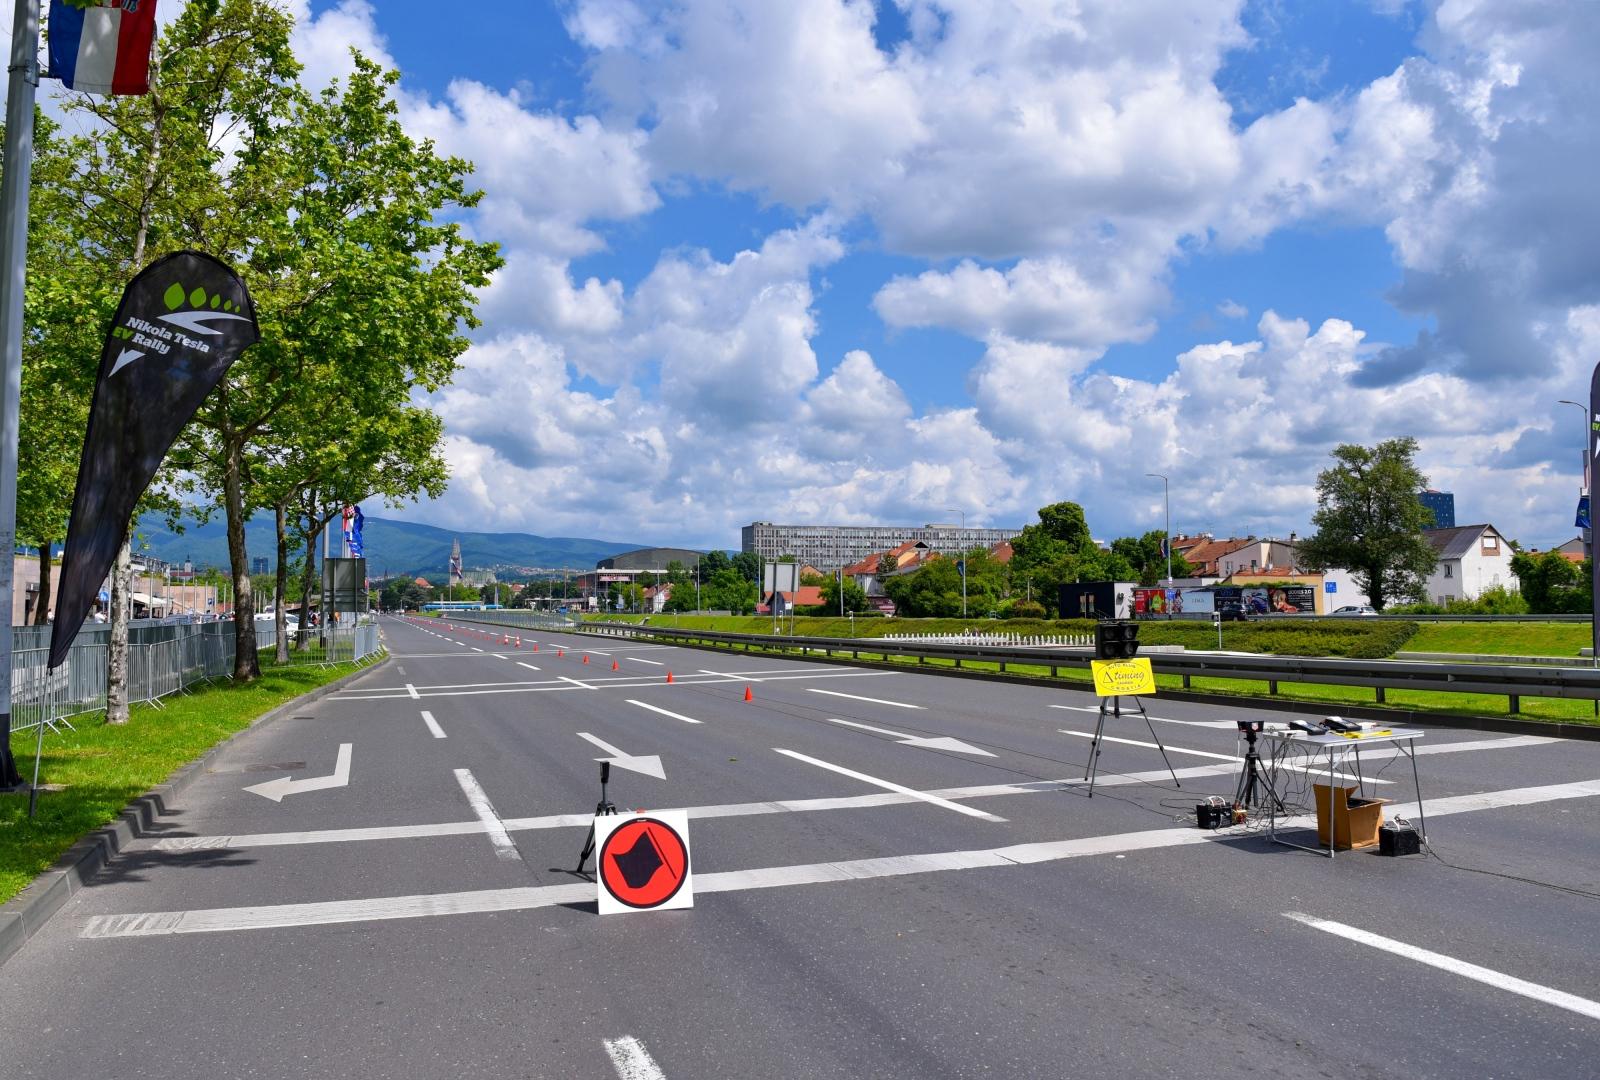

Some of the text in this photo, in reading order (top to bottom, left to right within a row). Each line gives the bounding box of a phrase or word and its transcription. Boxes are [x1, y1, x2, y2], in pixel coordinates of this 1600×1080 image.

[112, 326, 170, 354] EV Rally
[126, 317, 209, 352] Nikola Tesla
